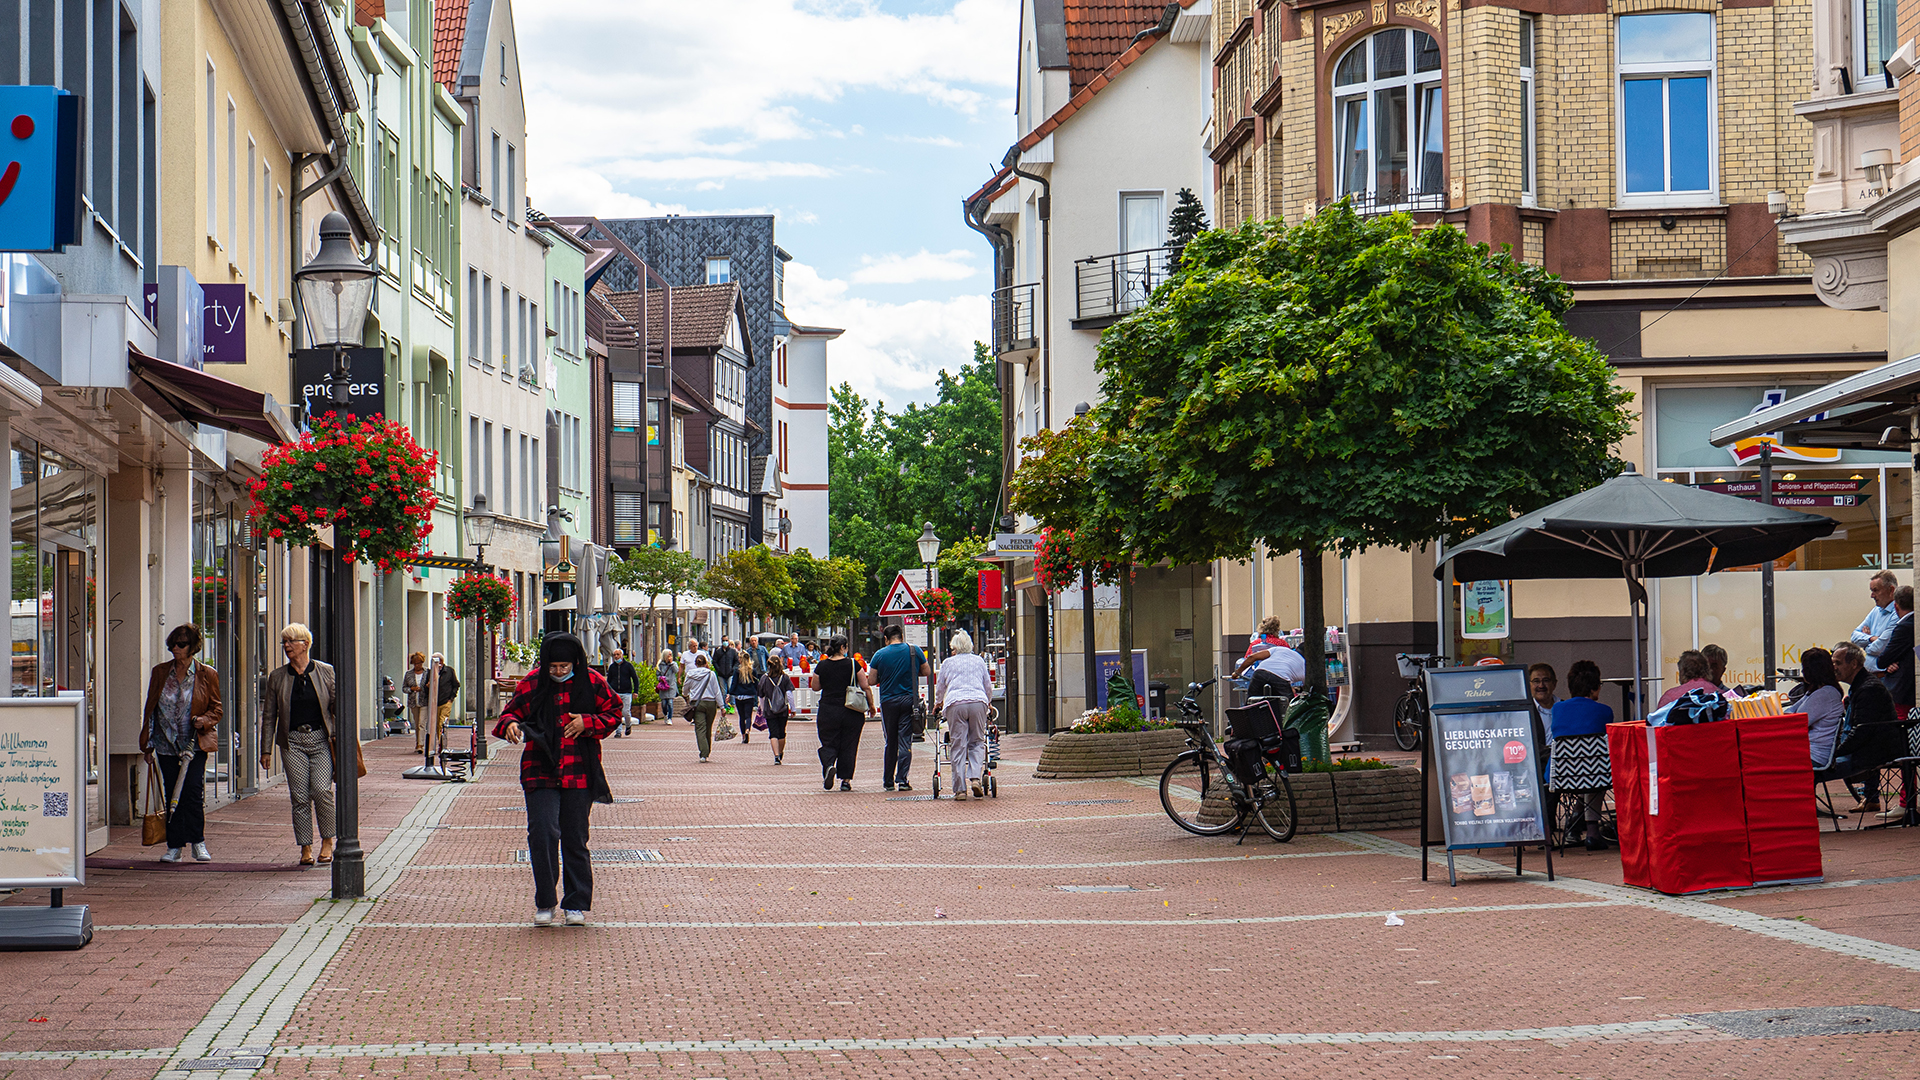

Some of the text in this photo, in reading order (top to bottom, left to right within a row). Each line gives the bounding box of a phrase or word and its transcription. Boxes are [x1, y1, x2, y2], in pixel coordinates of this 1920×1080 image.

[303, 383, 379, 399] engers
[1814, 482, 1856, 491] Pflegestützpunkt
[1777, 497, 1815, 505] Wallstraße
[1464, 690, 1494, 698] Tchibo
[1443, 727, 1525, 740] LIEBLINGSKAFFEE
[0, 732, 48, 750] Willkommen
[1445, 739, 1492, 750] GESUCHT?
